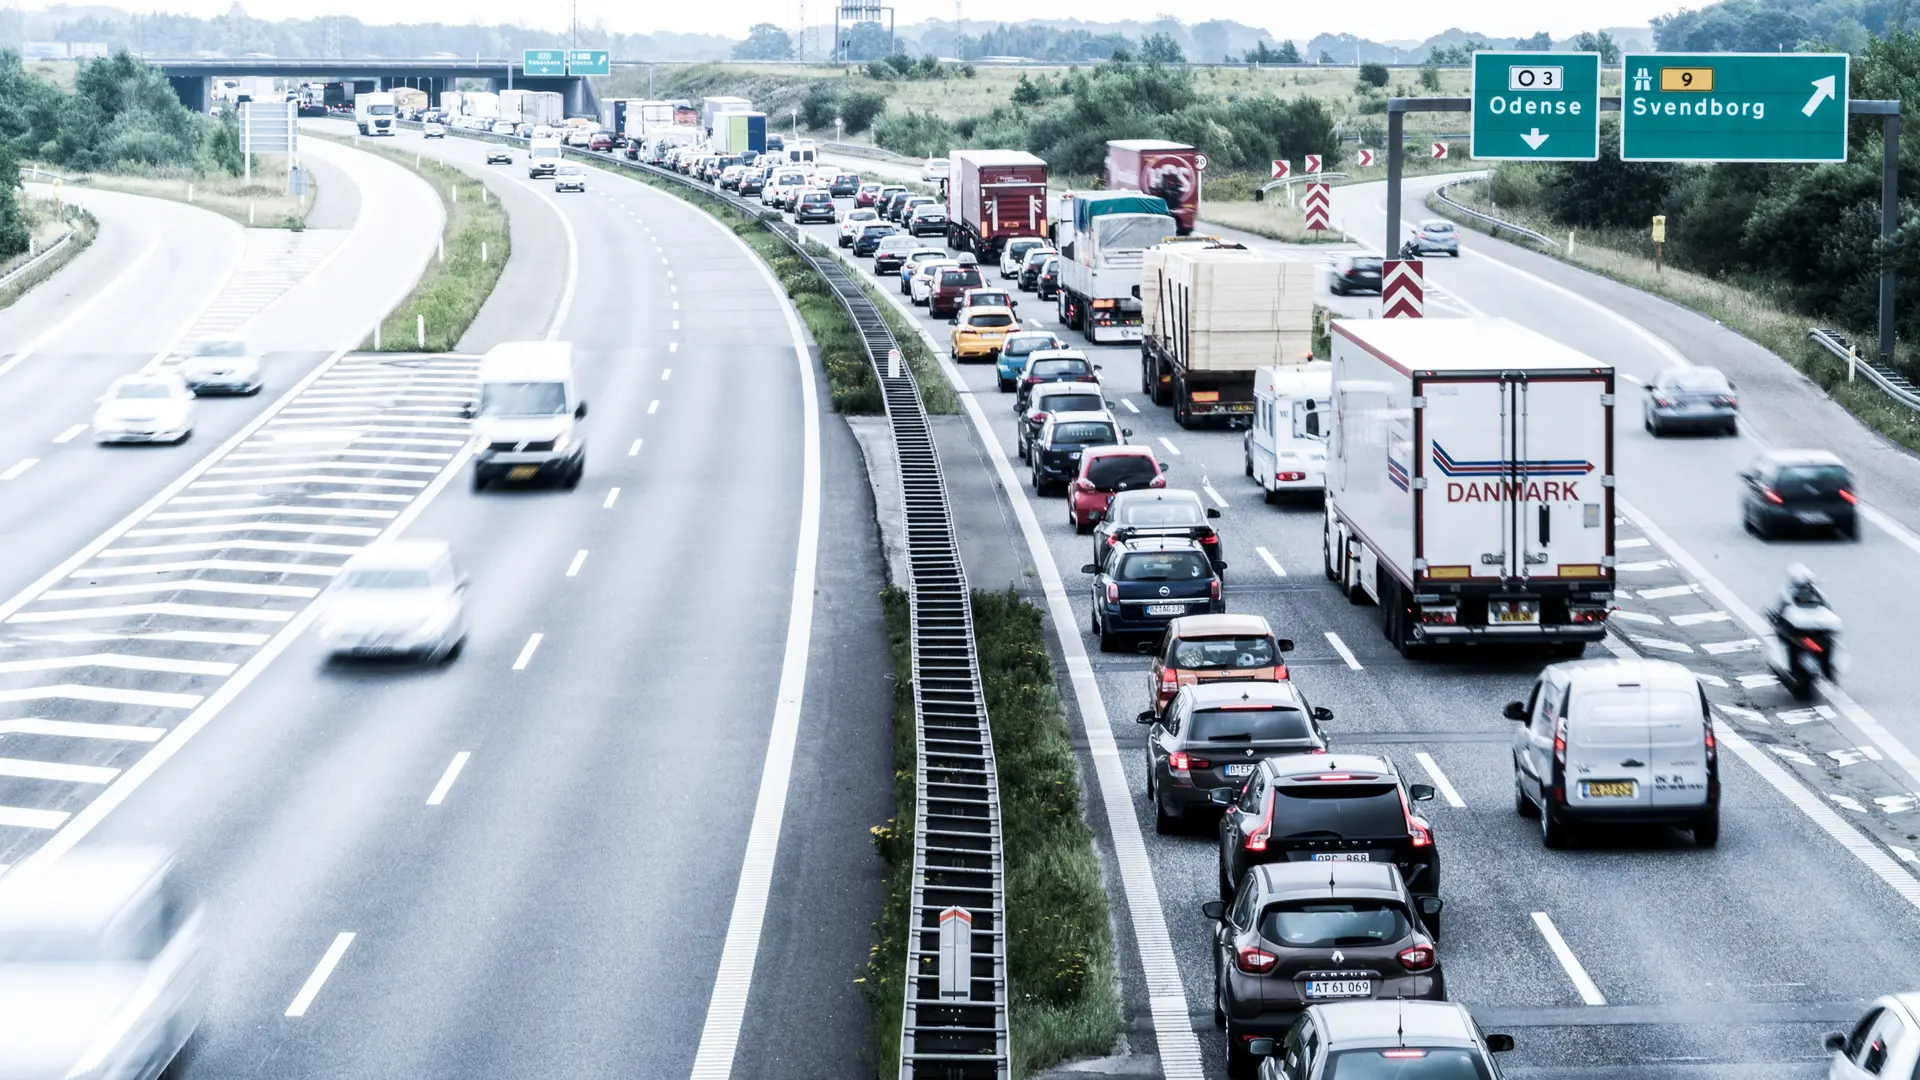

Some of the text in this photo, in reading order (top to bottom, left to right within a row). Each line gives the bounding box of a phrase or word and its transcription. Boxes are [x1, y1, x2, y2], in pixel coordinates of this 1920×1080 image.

[1518, 70, 1553, 87] O 3
[1681, 72, 1693, 87] 9
[1489, 96, 1582, 115] Odense
[1633, 98, 1765, 120] Svendborg
[1447, 481, 1580, 502] DANMARK
[1315, 981, 1369, 993] AT 61 069
